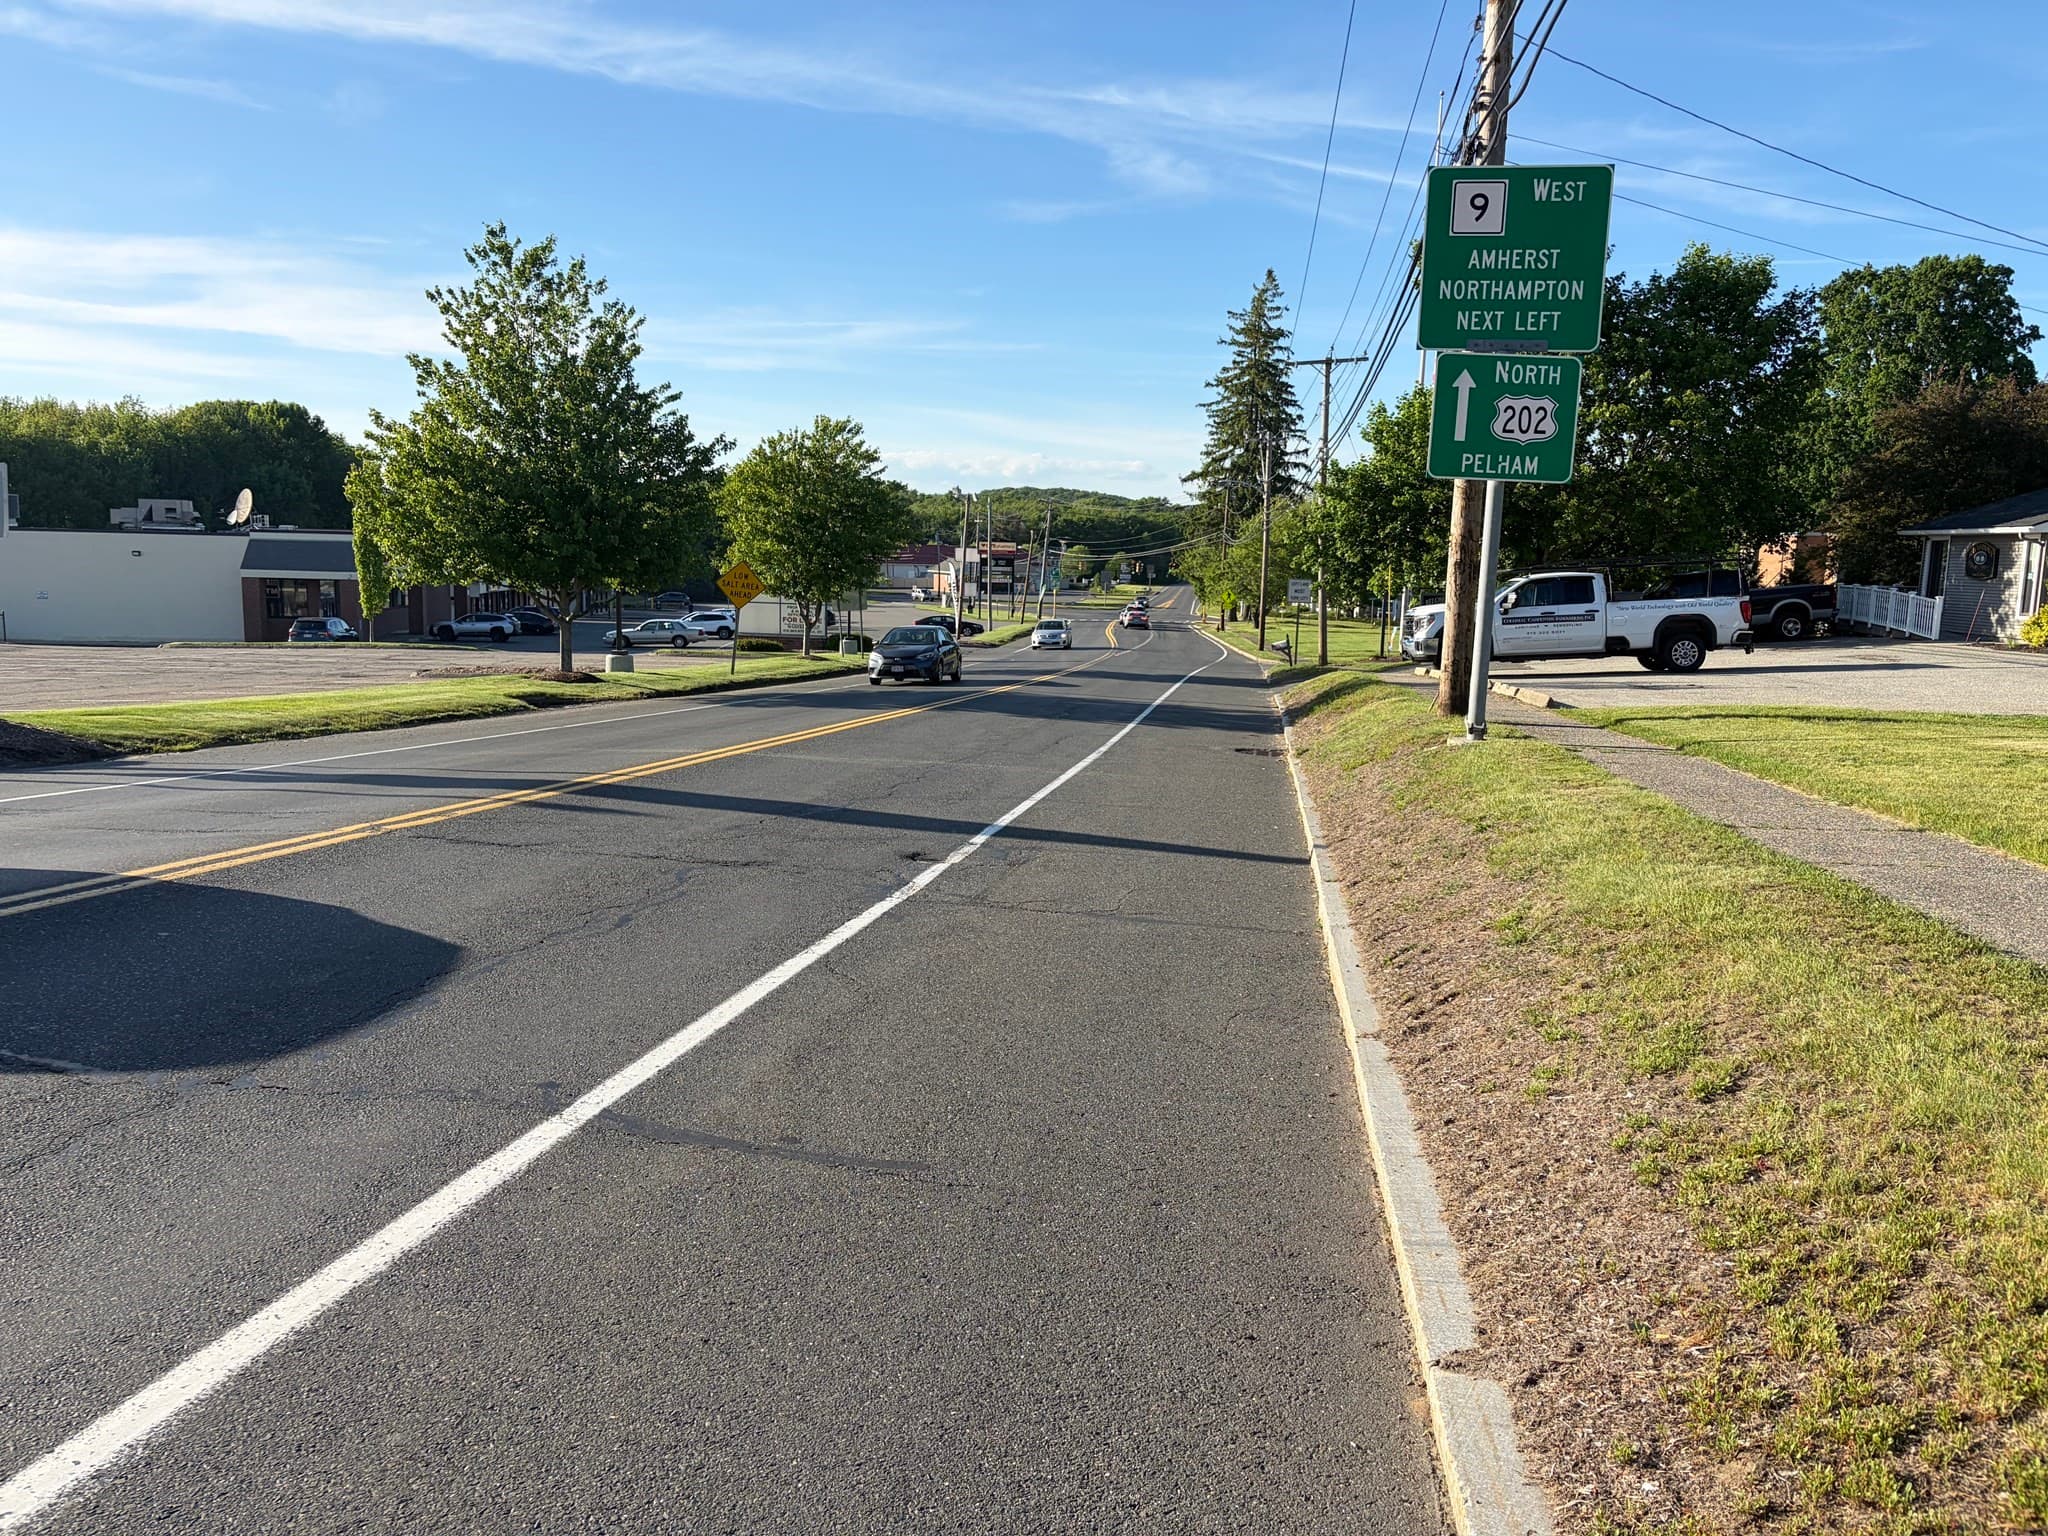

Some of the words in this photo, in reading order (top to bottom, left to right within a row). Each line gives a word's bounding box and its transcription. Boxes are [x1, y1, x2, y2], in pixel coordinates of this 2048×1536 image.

[1533, 178, 1587, 202] WEST
[1469, 192, 1490, 223] 9
[1467, 249, 1561, 270] AMHERST
[1439, 280, 1585, 300] NORTHAMPTON
[1456, 311, 1505, 331] NEXT
[1514, 311, 1562, 331] LEFT
[1495, 361, 1561, 385] NORTH
[1502, 405, 1548, 435] 202
[1461, 453, 1539, 476] PELHAM
[722, 580, 739, 588] SALT
[741, 582, 760, 591] AREA
[734, 572, 749, 580] LOW
[730, 590, 752, 599] AHEAD
